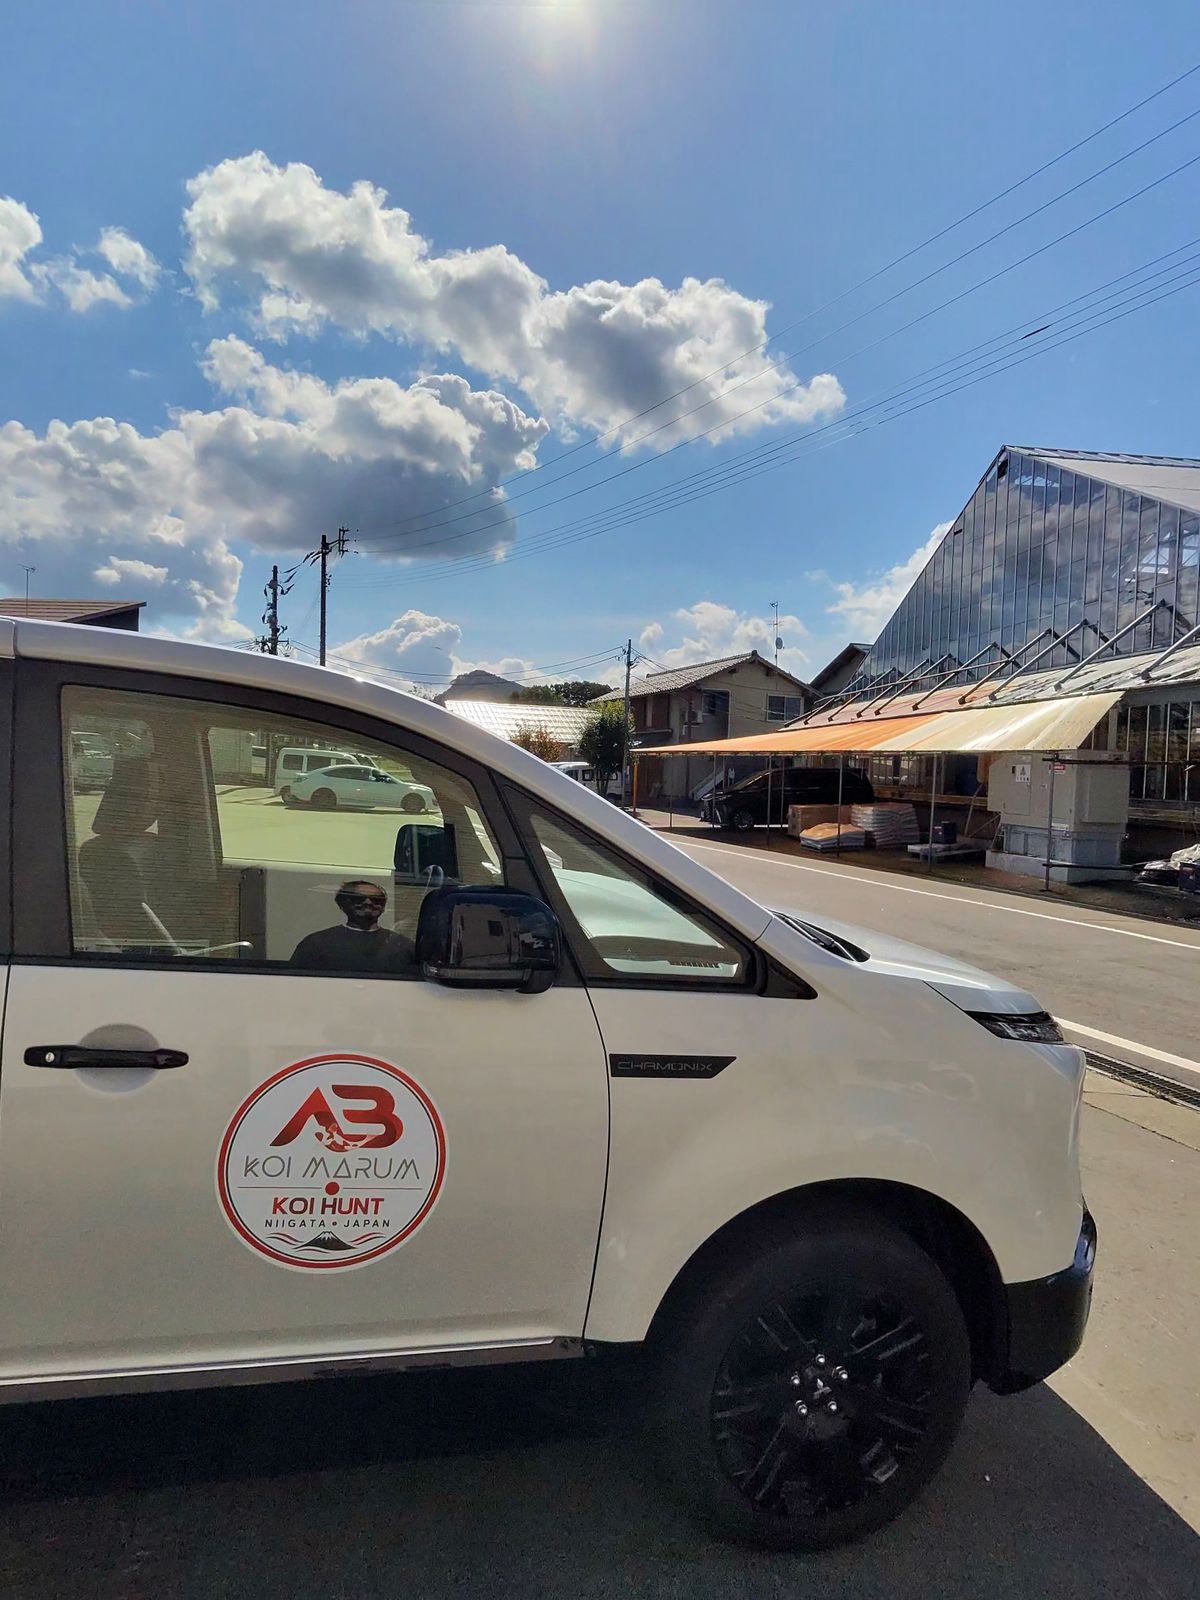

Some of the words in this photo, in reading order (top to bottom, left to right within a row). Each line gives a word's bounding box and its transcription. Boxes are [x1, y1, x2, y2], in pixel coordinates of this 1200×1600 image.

[617, 1061, 713, 1072] CHAMONIX
[243, 1155, 292, 1178] KOI
[302, 1156, 420, 1180] MARUM
[272, 1197, 314, 1215] KOI
[320, 1197, 385, 1215] HUNT
[264, 1219, 326, 1228] NIIGATA
[343, 1219, 391, 1228] JAPAN
